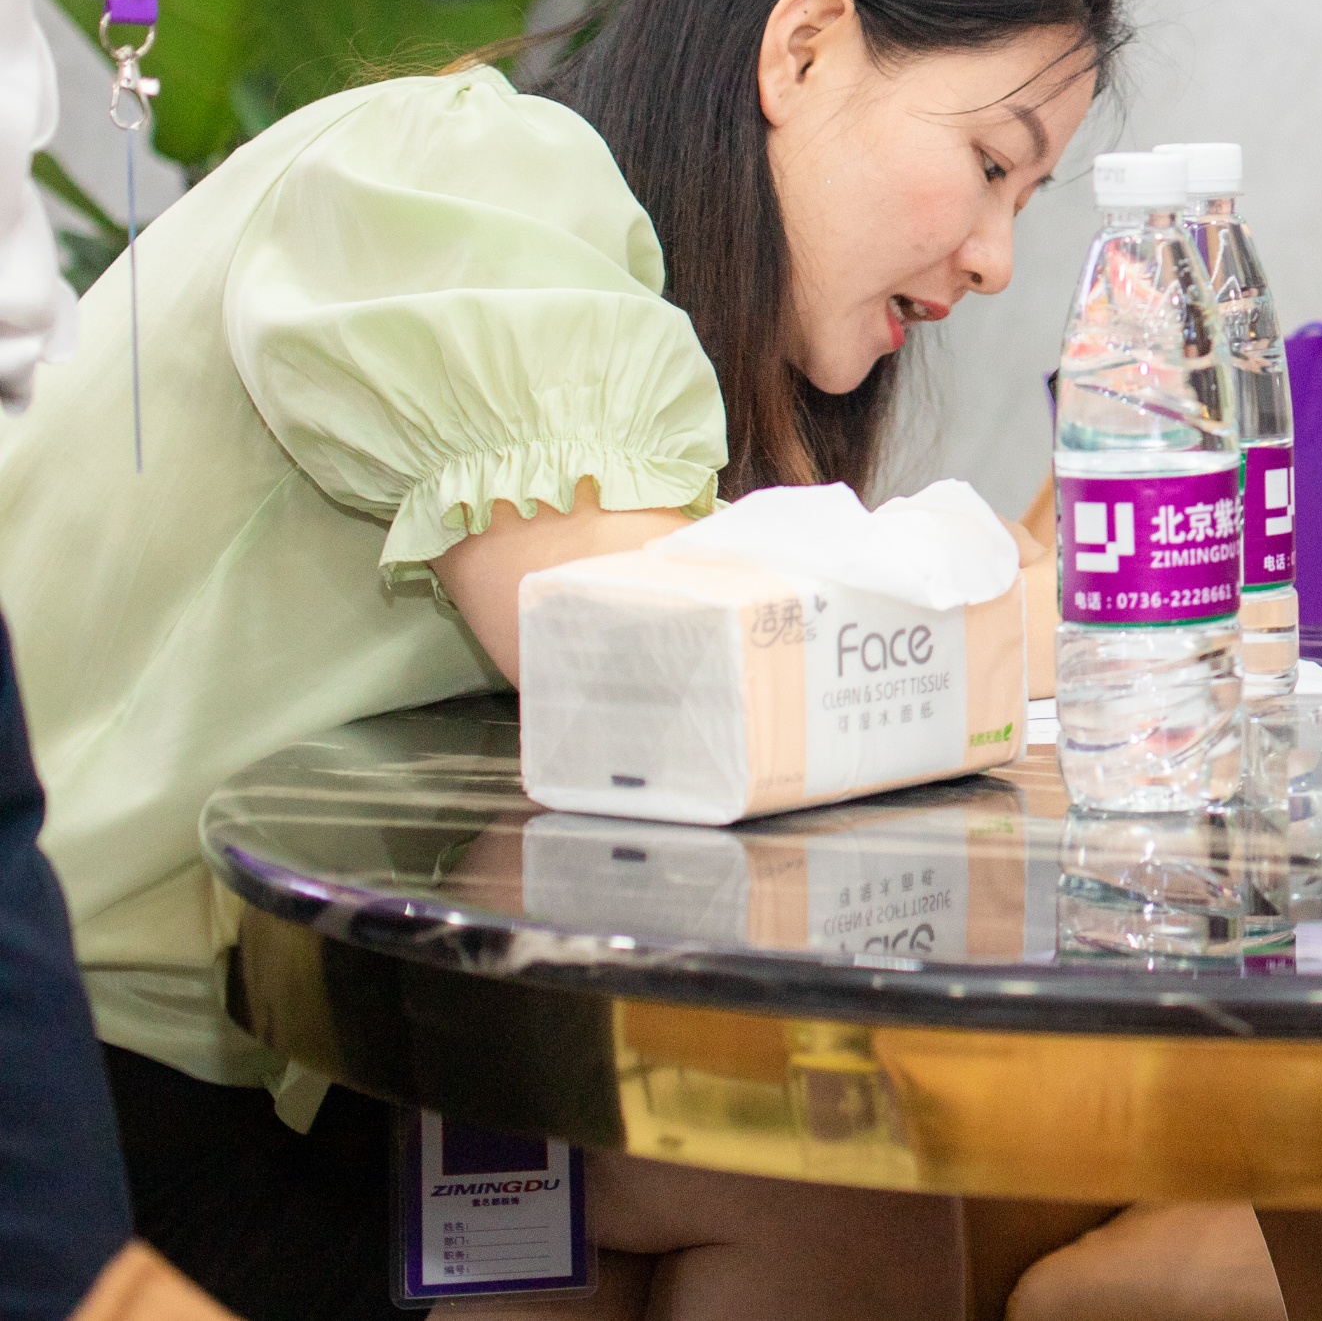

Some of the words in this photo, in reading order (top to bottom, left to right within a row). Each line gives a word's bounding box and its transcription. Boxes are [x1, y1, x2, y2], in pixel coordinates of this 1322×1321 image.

[837, 623, 934, 677] Face
[822, 686, 860, 711] CLEAN
[875, 679, 907, 702] SOFT
[910, 671, 950, 695] TISSUE
[430, 1179, 560, 1197] ZIMINGDU
